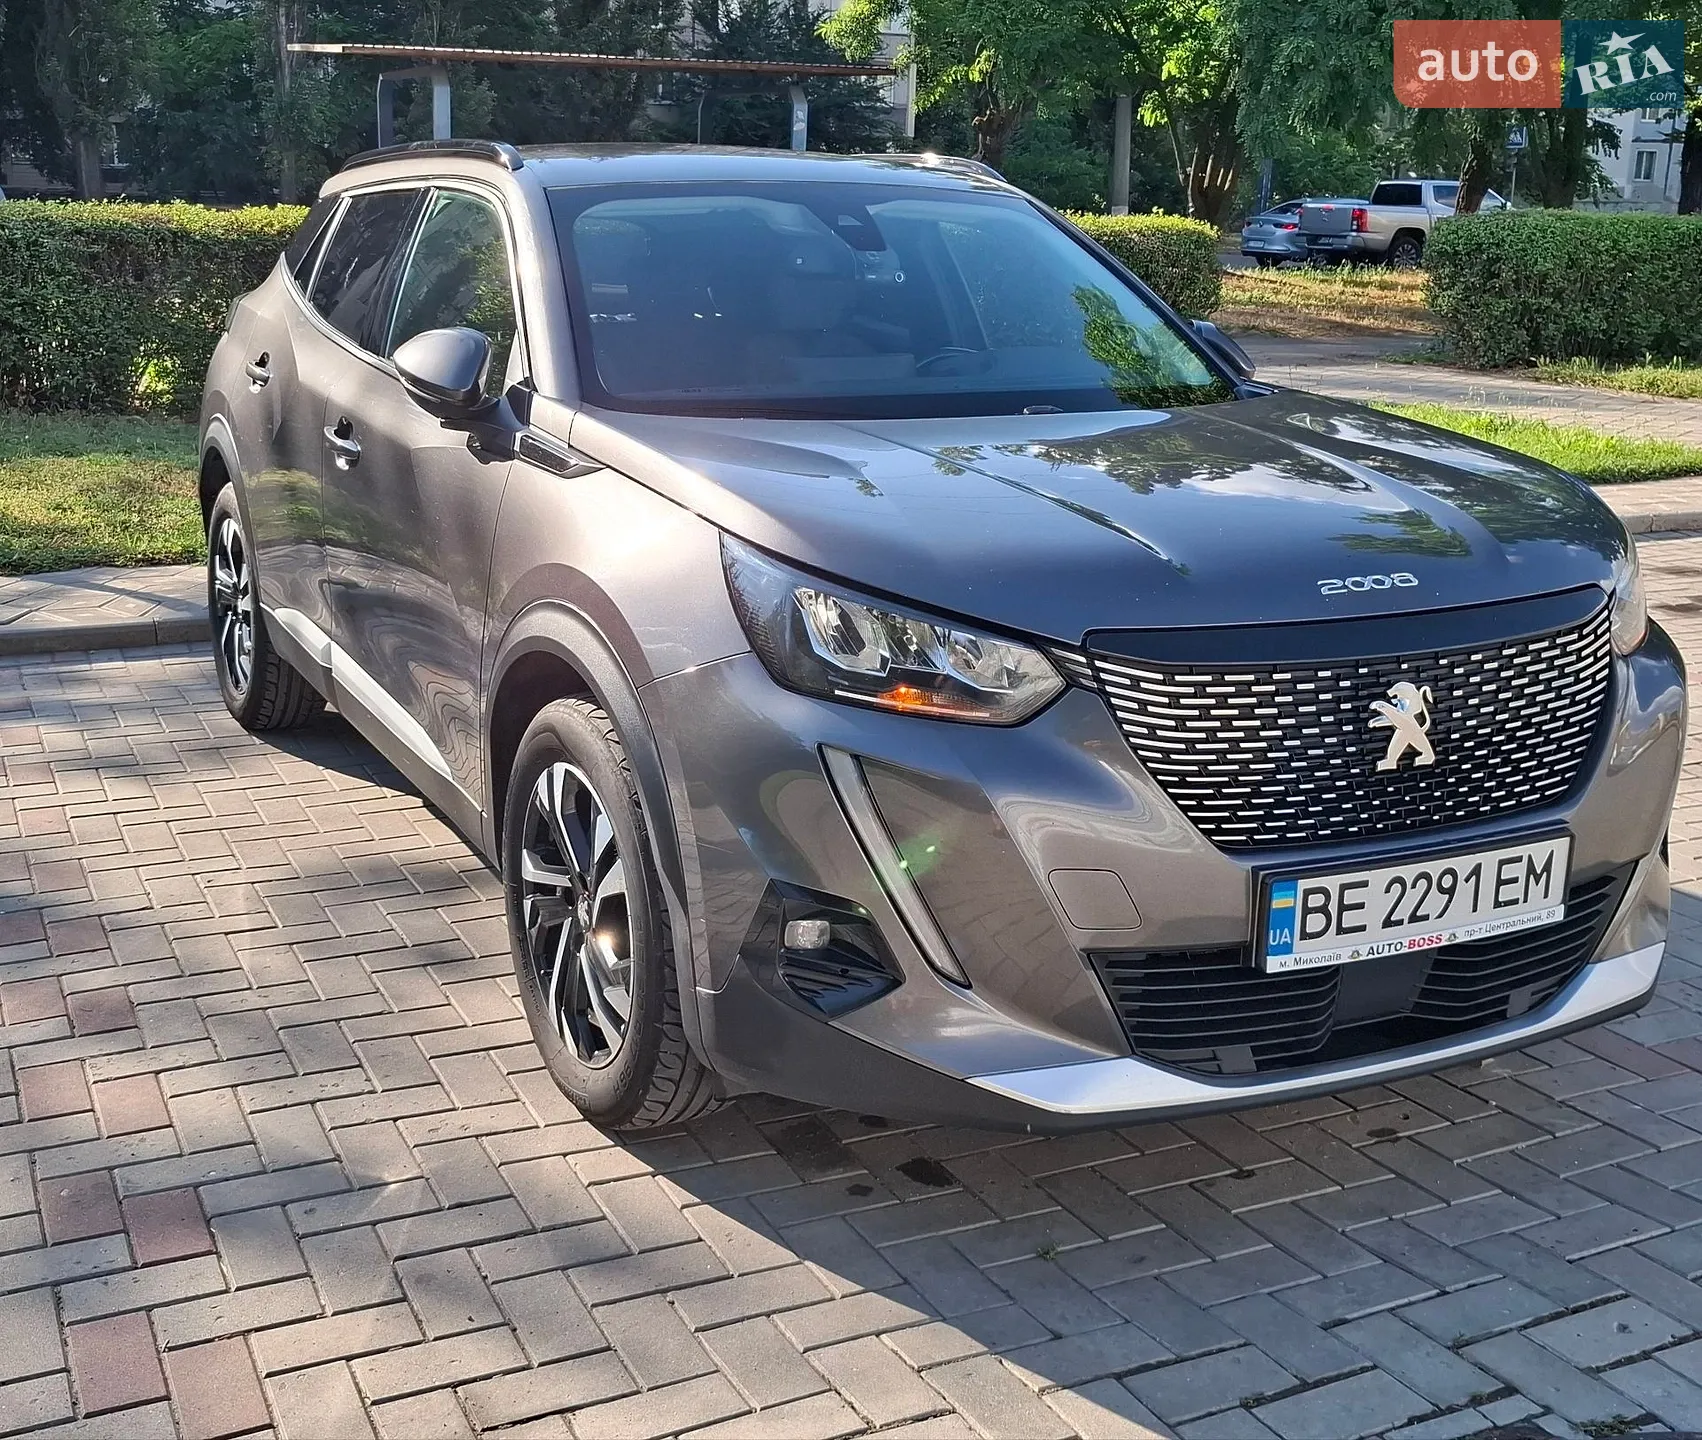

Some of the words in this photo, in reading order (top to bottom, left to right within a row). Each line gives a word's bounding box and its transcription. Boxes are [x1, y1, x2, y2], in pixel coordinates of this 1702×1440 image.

[1317, 573, 1418, 595] 2008
[1298, 879, 1370, 941] BE
[1381, 862, 1483, 930] 2291
[1492, 849, 1555, 909] EM
[1485, 912, 1544, 933] Центральний,
[1545, 909, 1556, 920] 89
[1269, 928, 1292, 945] UA
[1366, 933, 1443, 957] AUTO-BOSS
[1293, 952, 1342, 967] Миколаїв
